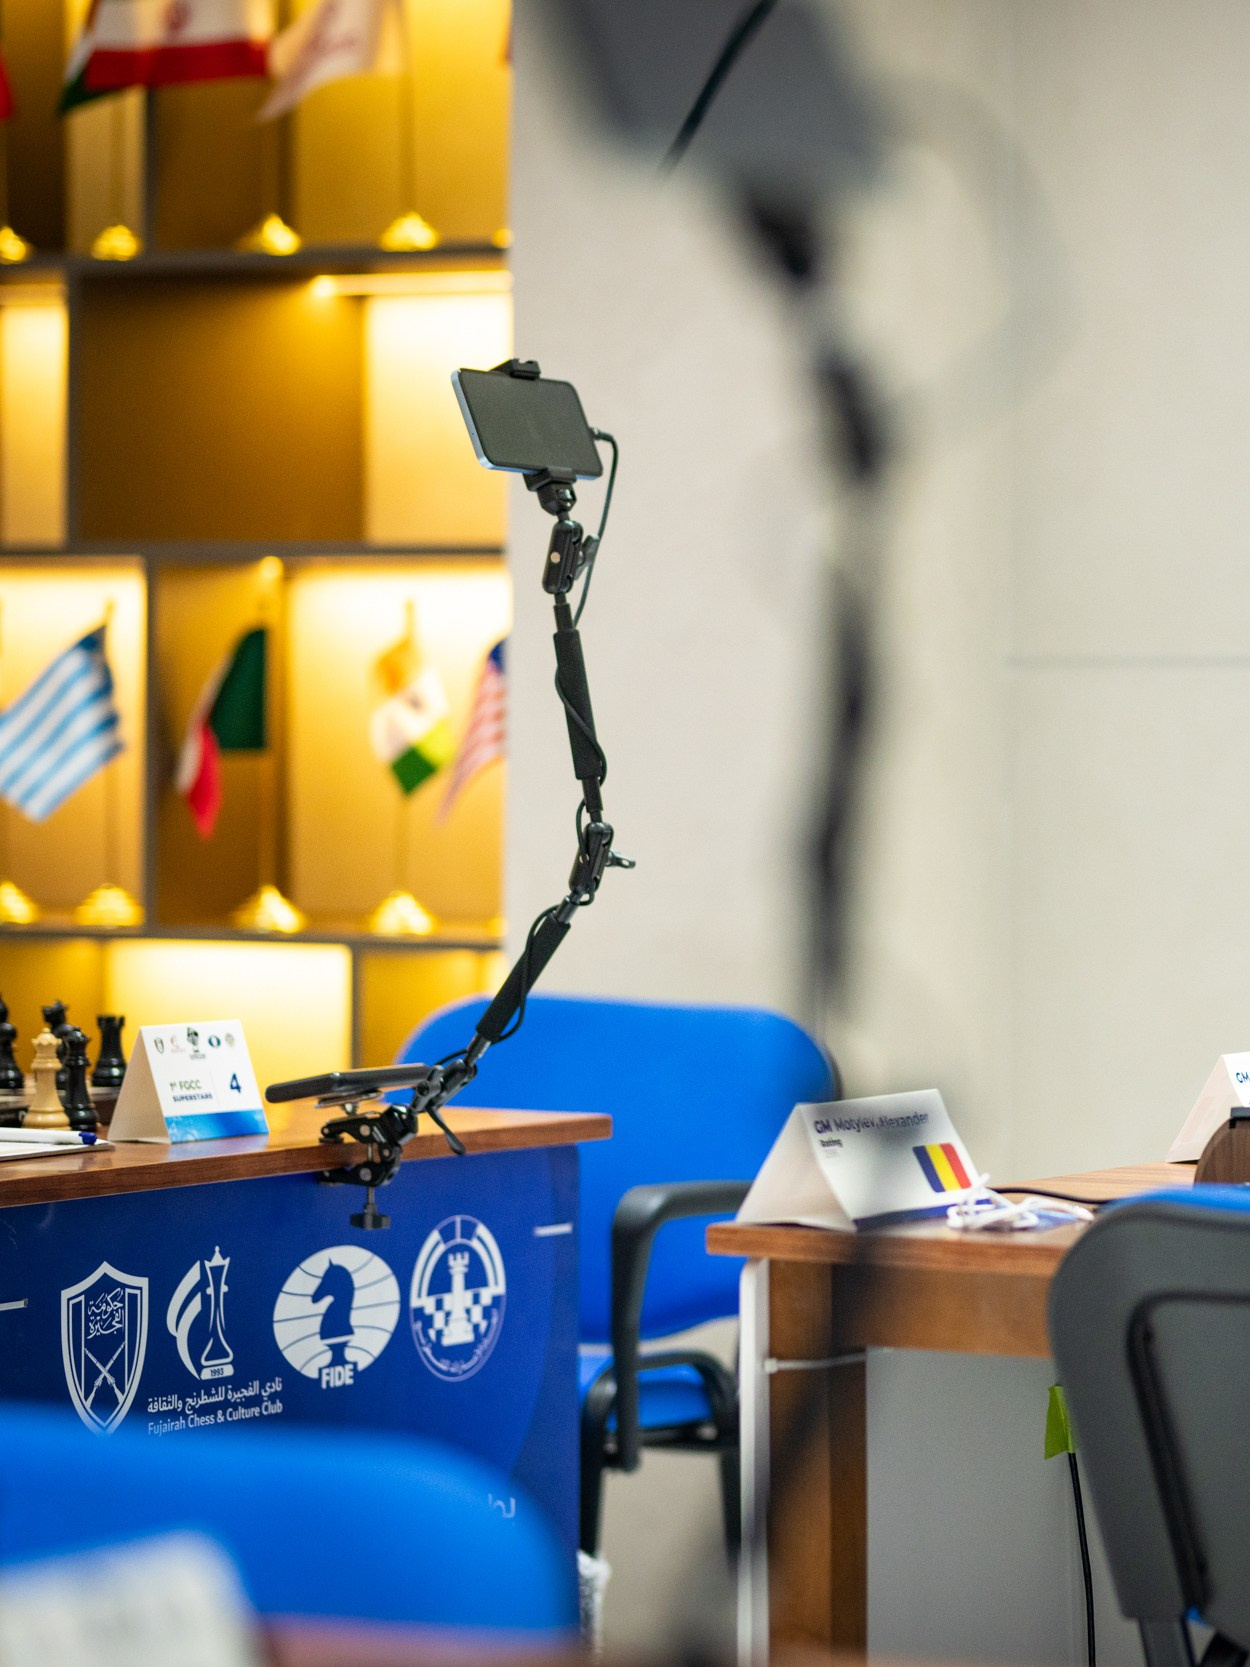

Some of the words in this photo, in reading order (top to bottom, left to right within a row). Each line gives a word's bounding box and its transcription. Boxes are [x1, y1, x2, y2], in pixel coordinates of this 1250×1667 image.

[230, 1073, 241, 1093] 4
[173, 1093, 213, 1102] SUPERSTARS
[814, 1119, 833, 1134] GM
[210, 1367, 224, 1377] 1993
[321, 1363, 354, 1390] FIDE
[227, 1380, 260, 1402] الفجيرة
[261, 1377, 283, 1400] نادي
[147, 1394, 183, 1413] والثقافة
[185, 1386, 225, 1414] للشطرنج
[148, 1416, 186, 1437] Fujairah
[188, 1413, 215, 1428] Chess
[216, 1409, 225, 1423] &
[226, 1405, 260, 1422] Culture
[262, 1399, 283, 1415] Club
